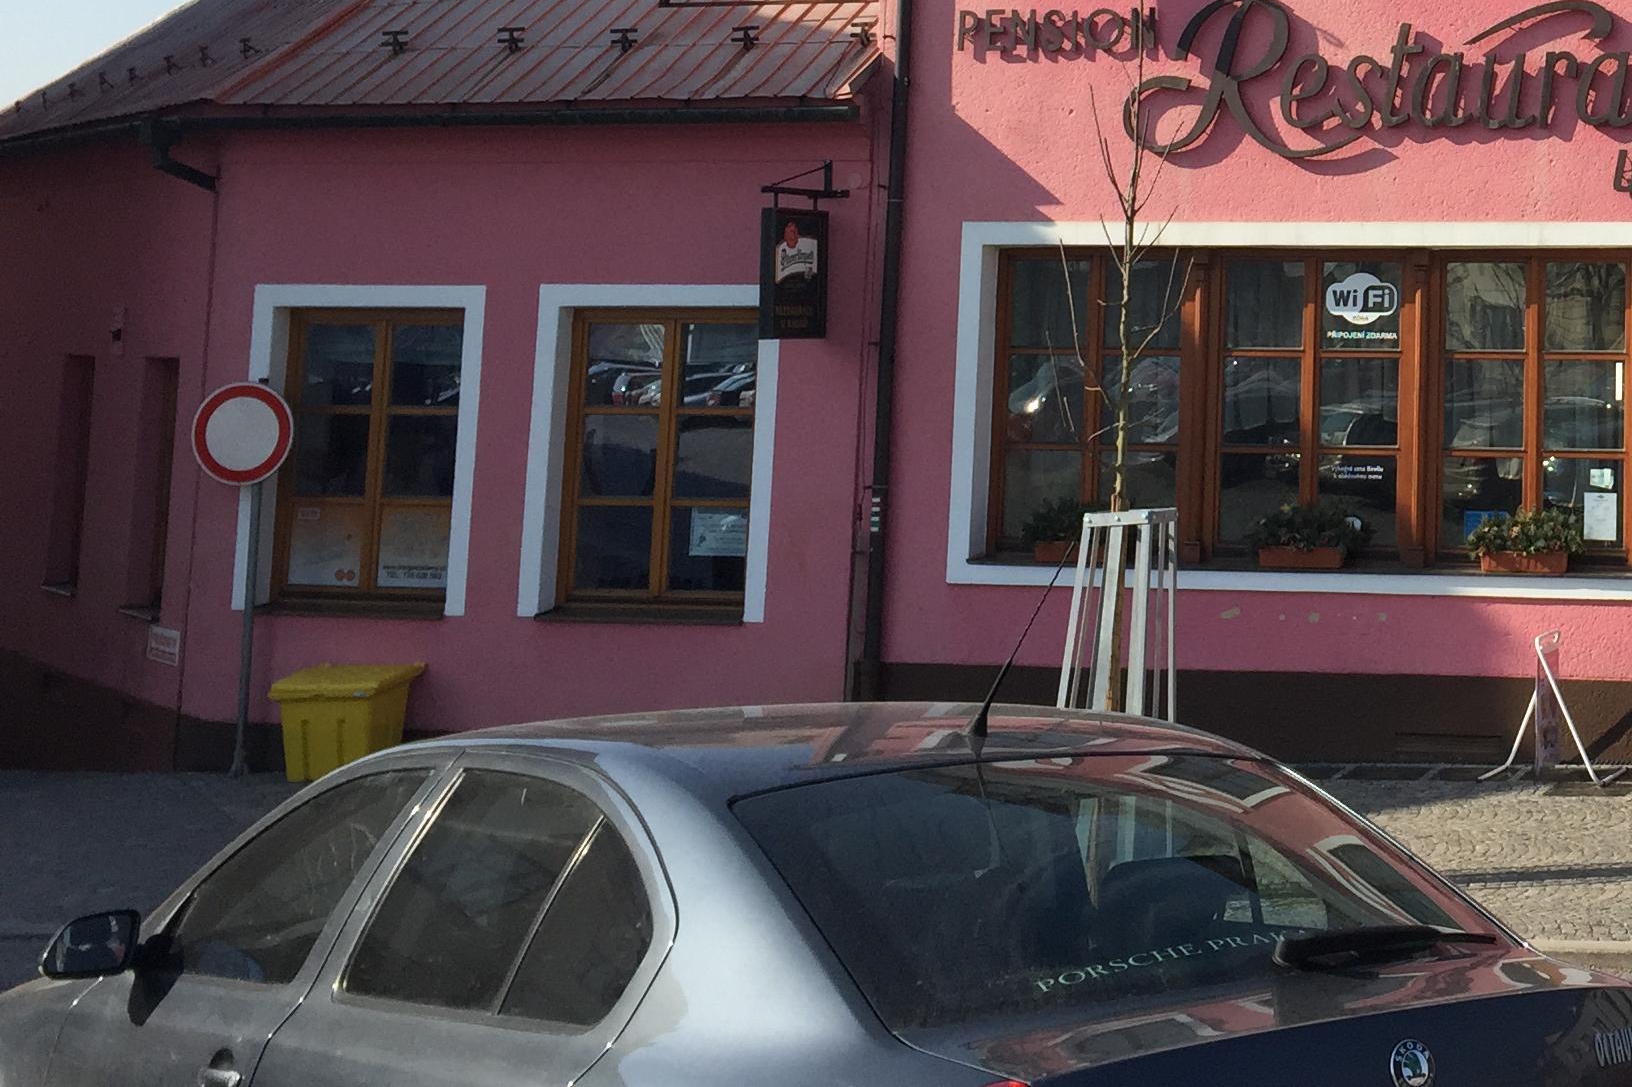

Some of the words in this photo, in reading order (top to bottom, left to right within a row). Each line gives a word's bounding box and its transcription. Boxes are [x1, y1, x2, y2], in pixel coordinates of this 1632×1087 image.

[957, 7, 1156, 52] PENSION
[1365, 331, 1398, 340] ZDARMA
[1036, 943, 1202, 993] PORSCHE
